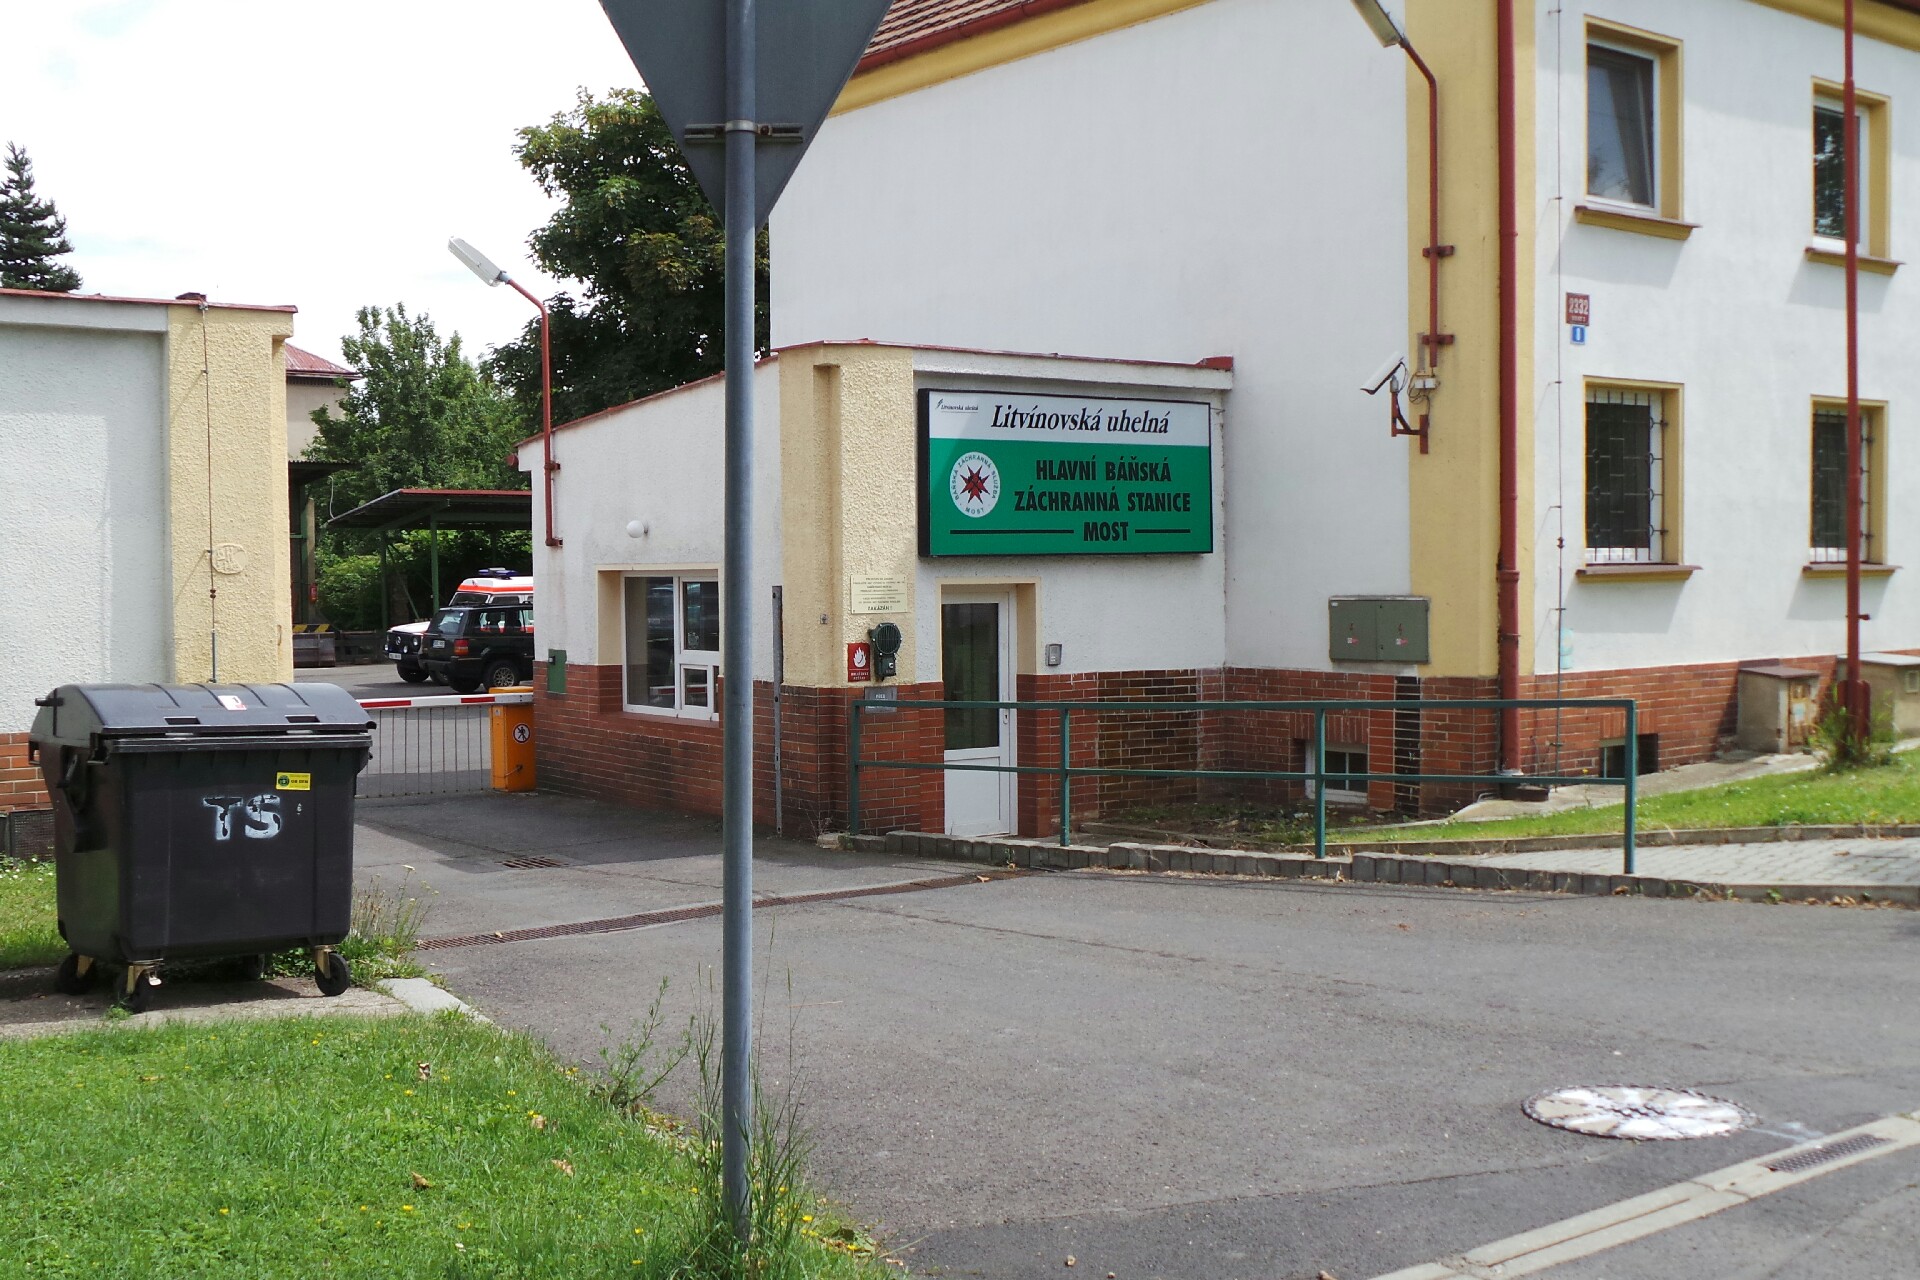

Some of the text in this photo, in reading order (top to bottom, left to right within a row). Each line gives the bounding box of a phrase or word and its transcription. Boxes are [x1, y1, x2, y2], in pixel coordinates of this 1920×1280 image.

[991, 404, 1171, 434] Litvínovská uhelná
[1036, 455, 1172, 482] HLAVNÍ BÁŇSKÁ
[965, 507, 984, 515] MOST
[1014, 486, 1191, 512] ZÁCHRANNÁ STANICE
[1083, 522, 1129, 542] MOST
[203, 794, 283, 841] TS
